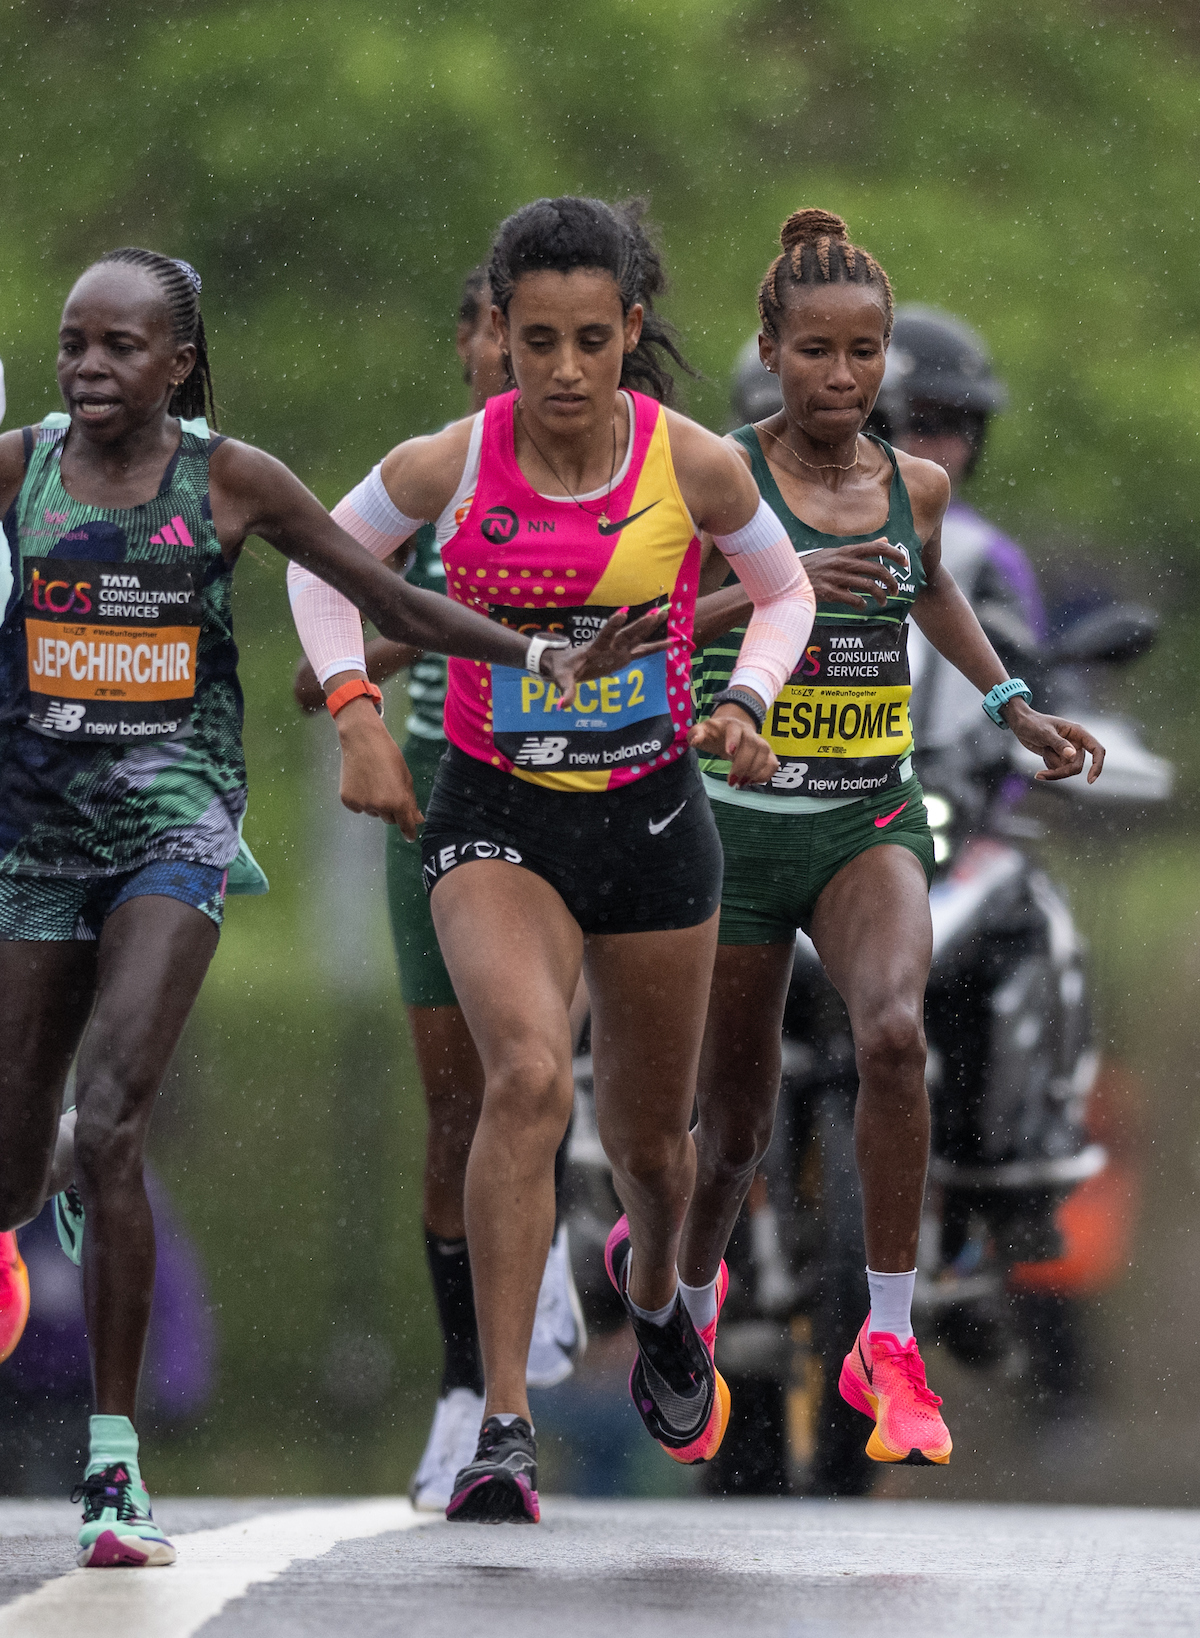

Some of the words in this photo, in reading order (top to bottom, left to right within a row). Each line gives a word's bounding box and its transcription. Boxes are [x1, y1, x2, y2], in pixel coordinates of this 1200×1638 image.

[528, 520, 556, 533] NN
[100, 574, 141, 589] TATA
[32, 570, 92, 615] tcs
[99, 589, 192, 605] CONSULTANCY
[98, 604, 160, 619] SERVICES
[829, 637, 864, 649] TATA
[32, 637, 190, 684] JEPCHIRCHIR
[828, 650, 901, 663] CONSULTANCY
[826, 665, 879, 678] SERVICES
[521, 676, 623, 714] PACE
[627, 669, 646, 708] 2
[85, 721, 118, 735] new
[119, 720, 178, 736] balance
[758, 701, 904, 741] ESHOME
[569, 752, 601, 765] new
[602, 739, 662, 763] balance
[808, 778, 839, 791] new
